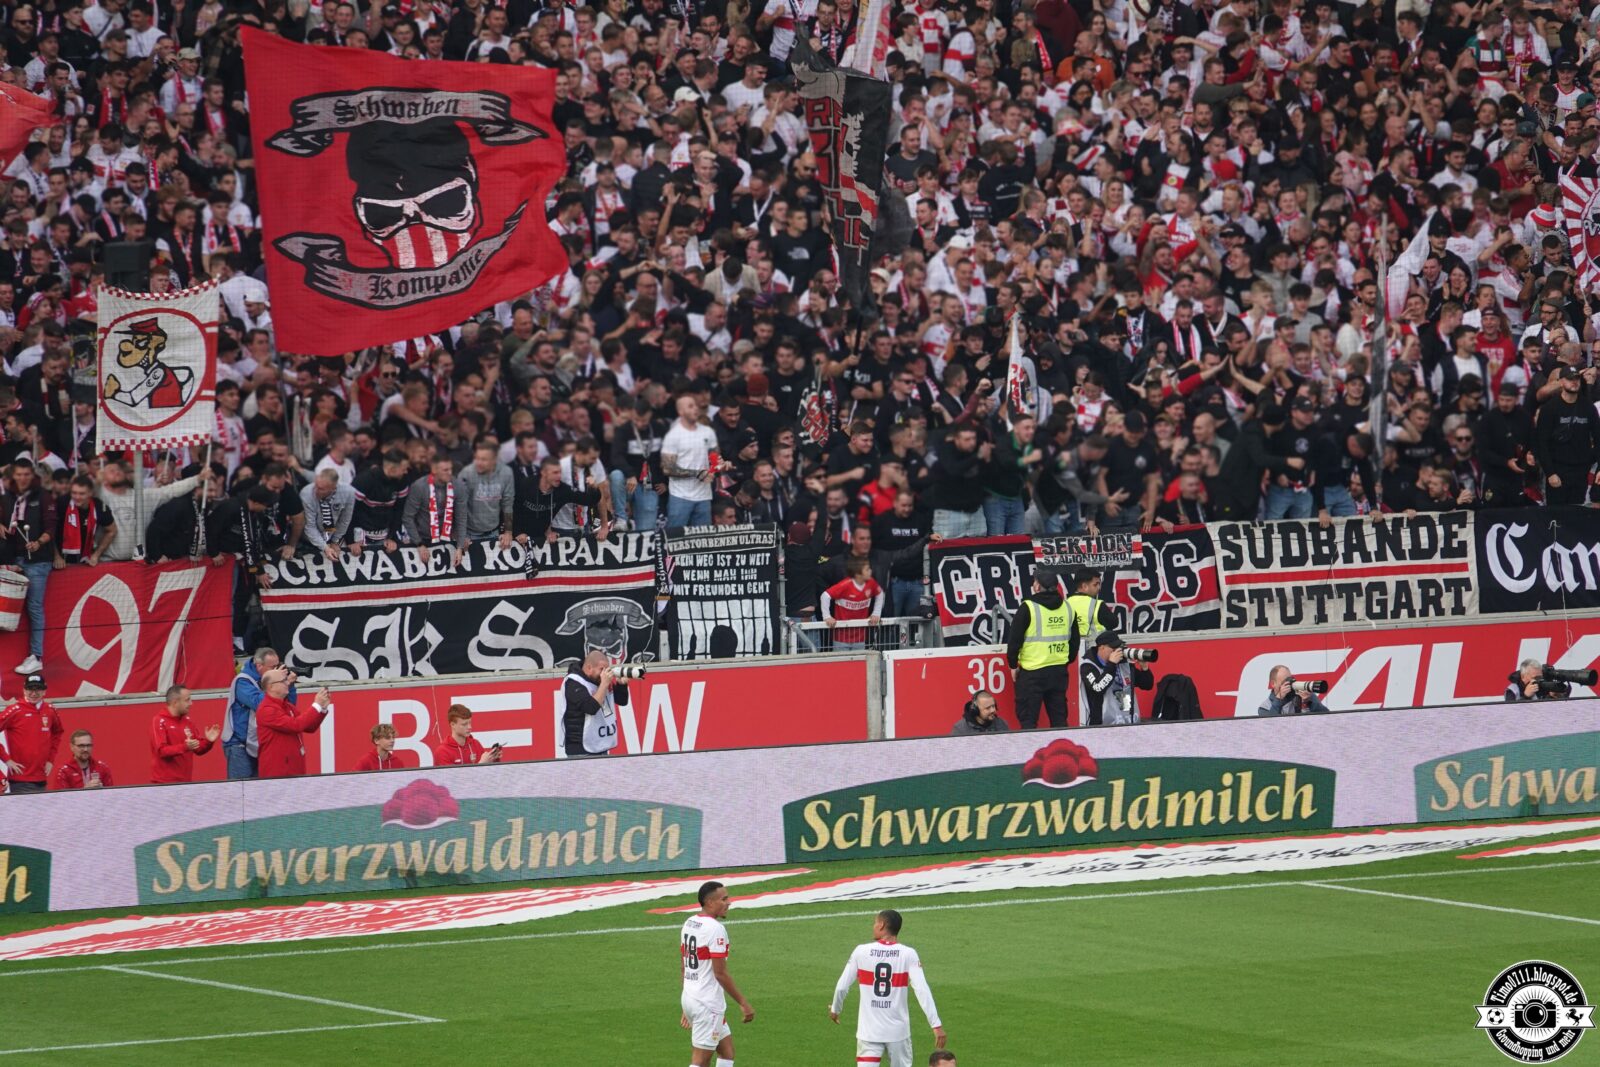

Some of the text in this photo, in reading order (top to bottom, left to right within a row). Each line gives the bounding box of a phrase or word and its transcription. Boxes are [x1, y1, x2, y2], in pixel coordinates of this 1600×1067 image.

[333, 95, 460, 125] Schwaben
[368, 250, 483, 300] Kompanie
[739, 534, 774, 546] ULTRAS
[1040, 533, 1133, 556] SEKTION
[1218, 511, 1469, 572] SÜDBANDE
[675, 553, 771, 567] KEIN WEG IST ZU WEIT
[673, 581, 771, 596] MIT FREUNDEN GEHT
[1226, 577, 1472, 629] STUTTGART
[583, 603, 624, 615] Schwaben
[1048, 616, 1064, 624] SDS
[65, 566, 207, 696] 97
[1048, 643, 1065, 654] 1762
[967, 657, 1006, 695] 36
[1431, 755, 1598, 812] Schwa
[800, 768, 1317, 851] Schwarzwaldmilch
[152, 808, 684, 895] Schwarzwaldmilch
[873, 962, 892, 998] 8
